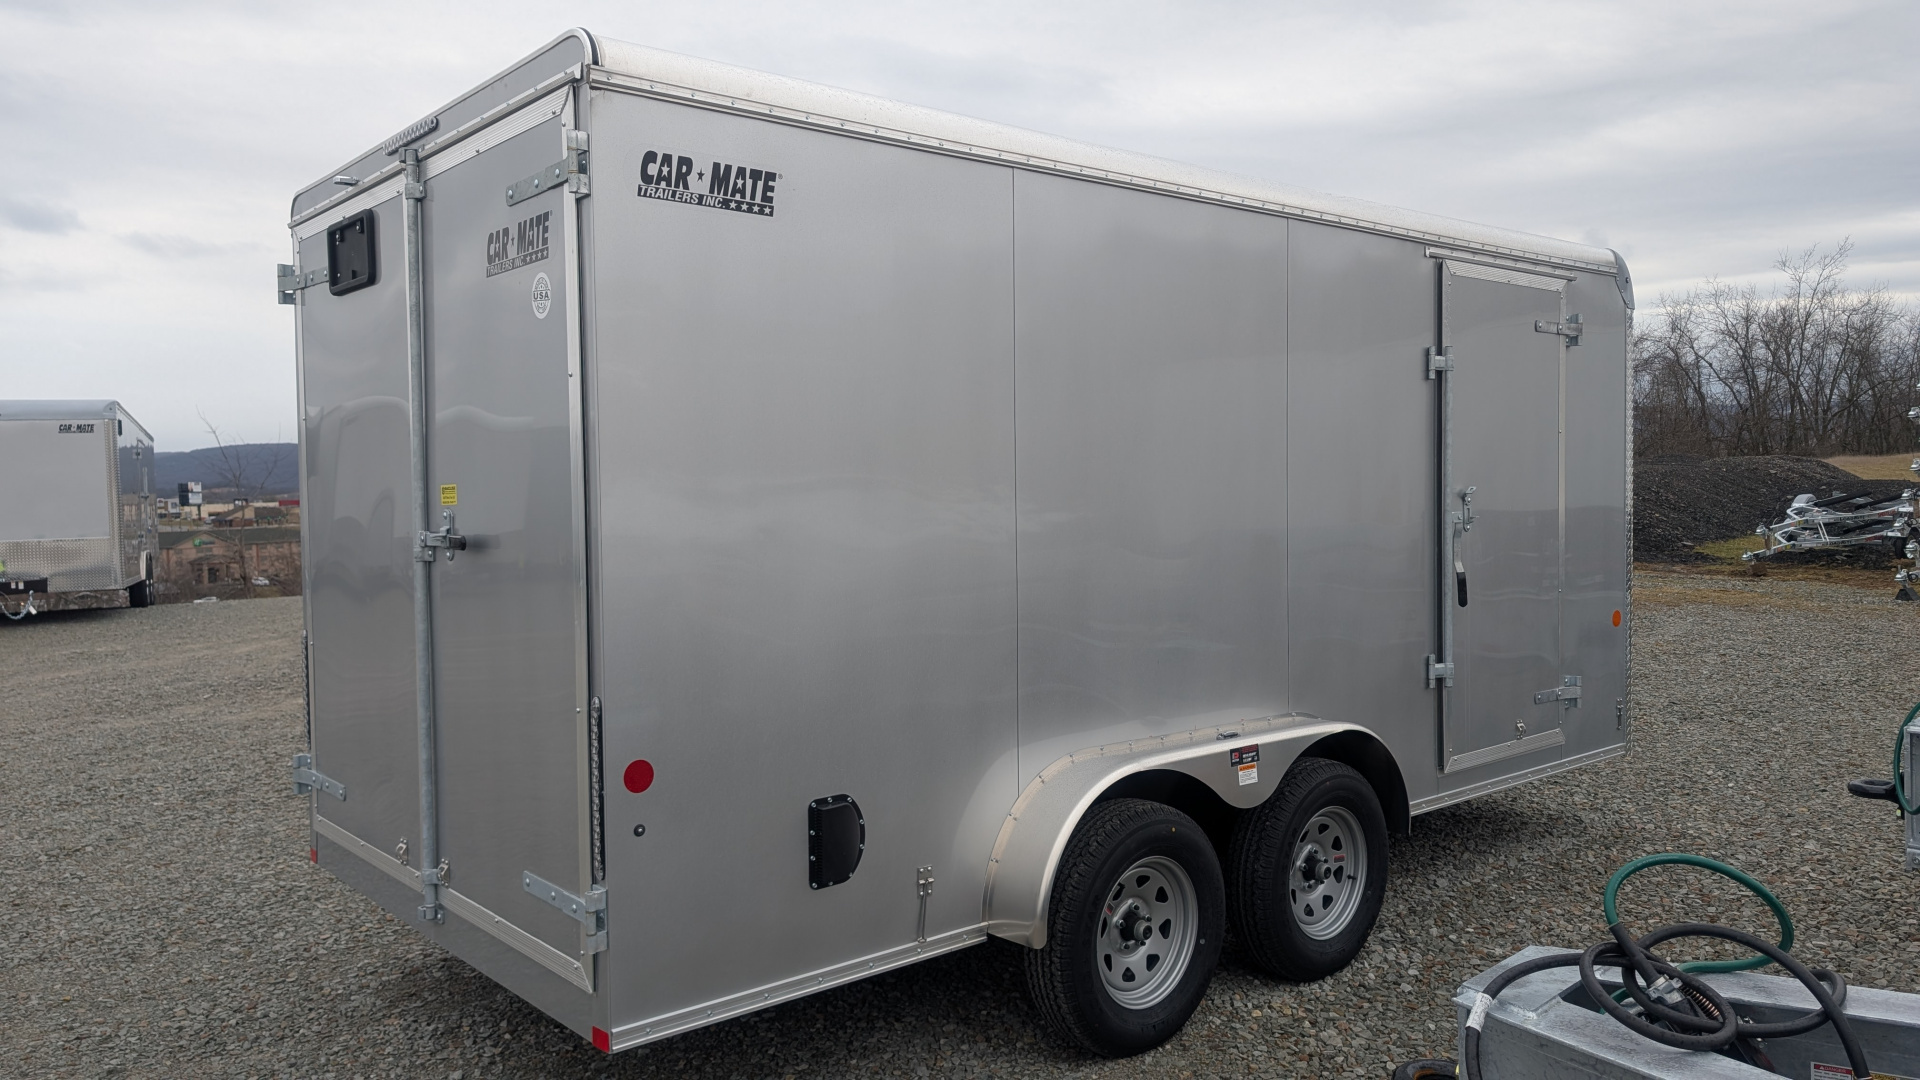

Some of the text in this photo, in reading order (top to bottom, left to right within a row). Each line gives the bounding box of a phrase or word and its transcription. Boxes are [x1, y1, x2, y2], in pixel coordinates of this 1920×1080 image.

[640, 150, 777, 204] CAR MATE
[639, 185, 726, 209] TRAILERS INC.
[487, 210, 550, 265] CAR MATE
[487, 259, 513, 276] TRAILERS
[533, 291, 550, 300] USA
